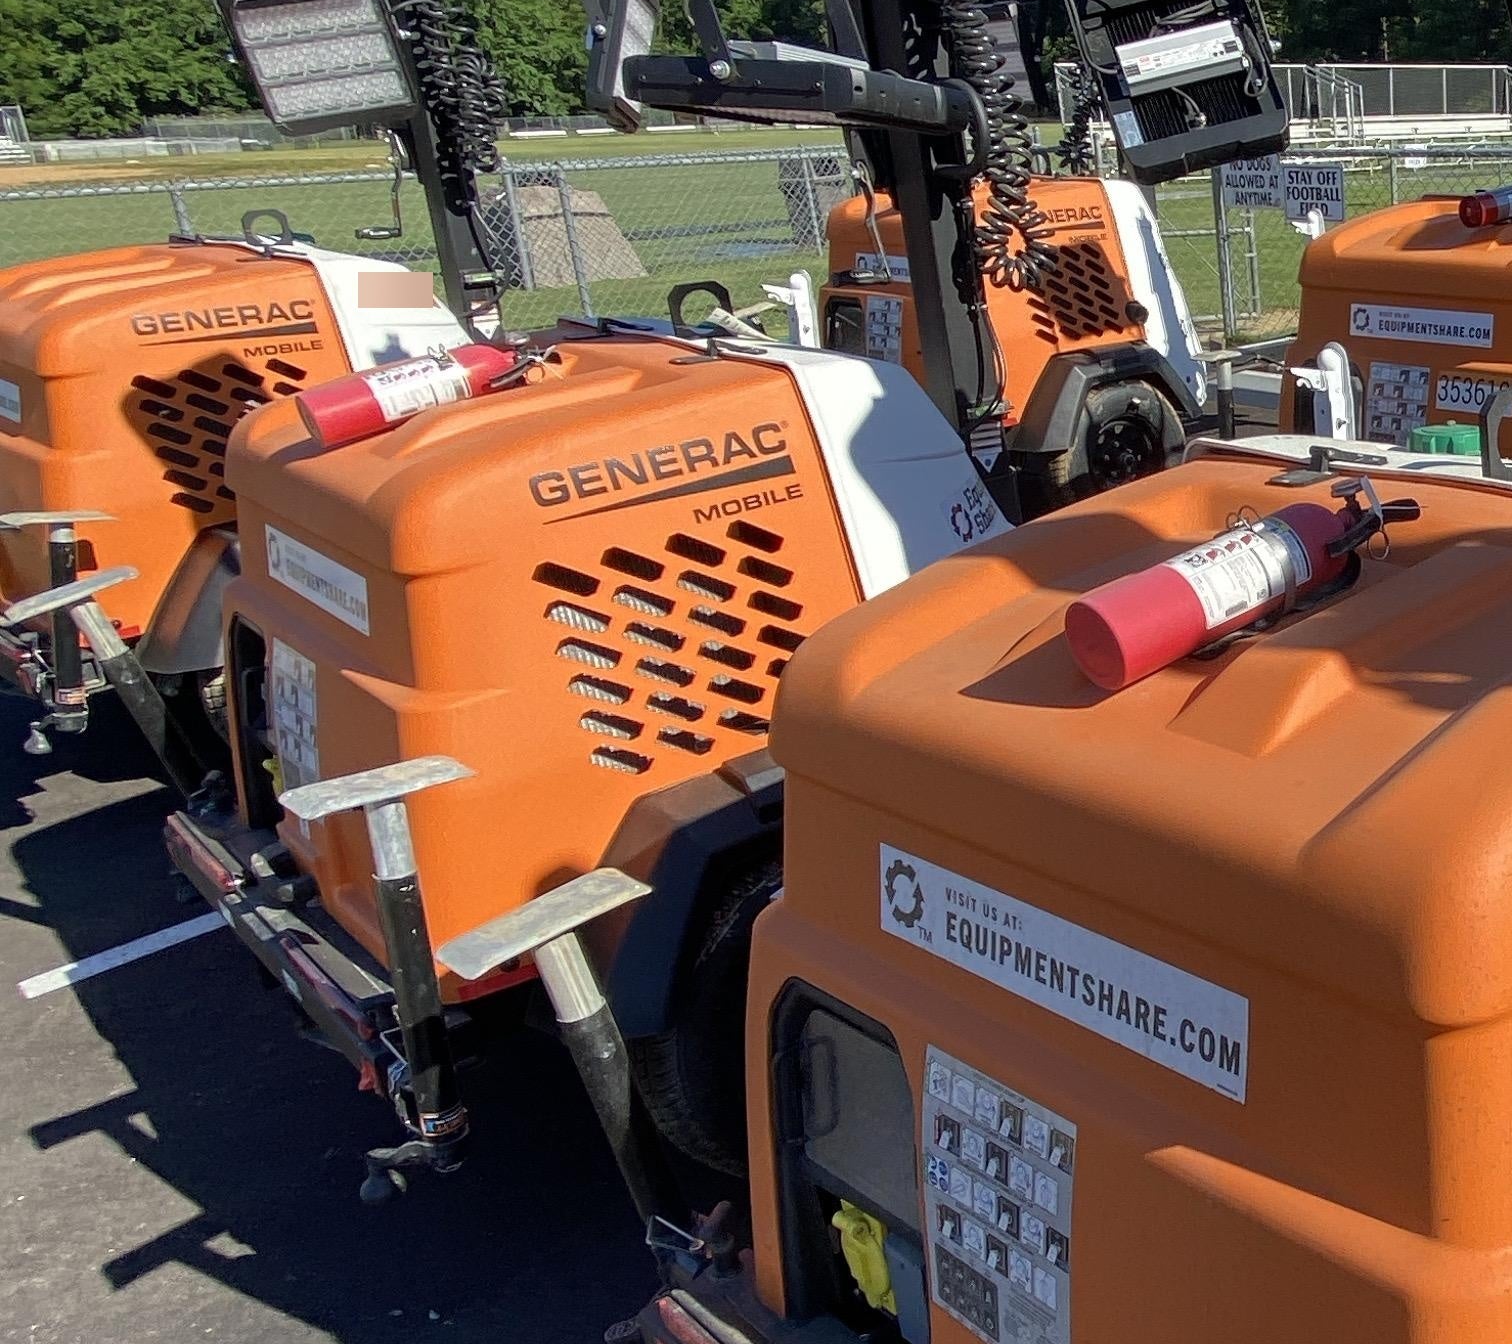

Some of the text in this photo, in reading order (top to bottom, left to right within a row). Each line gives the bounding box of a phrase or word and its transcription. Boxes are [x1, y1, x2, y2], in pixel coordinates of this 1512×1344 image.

[1225, 175, 1279, 189] ALLOWED AT
[1288, 171, 1337, 186] STAY OFF
[1235, 192, 1272, 205] ANYTIME
[1286, 187, 1341, 201] FOOTBALL
[131, 300, 314, 336] GENERAC
[1378, 319, 1491, 340] EQUIPMENTSHARE.COM
[243, 340, 324, 358] MOBILE
[528, 423, 788, 507] GENERAC
[693, 483, 803, 524] MOBILE
[945, 886, 1023, 932] VISIT US AT:
[917, 925, 933, 944] TM
[945, 911, 1241, 1076] EQUIPMENTSHARE.COM
